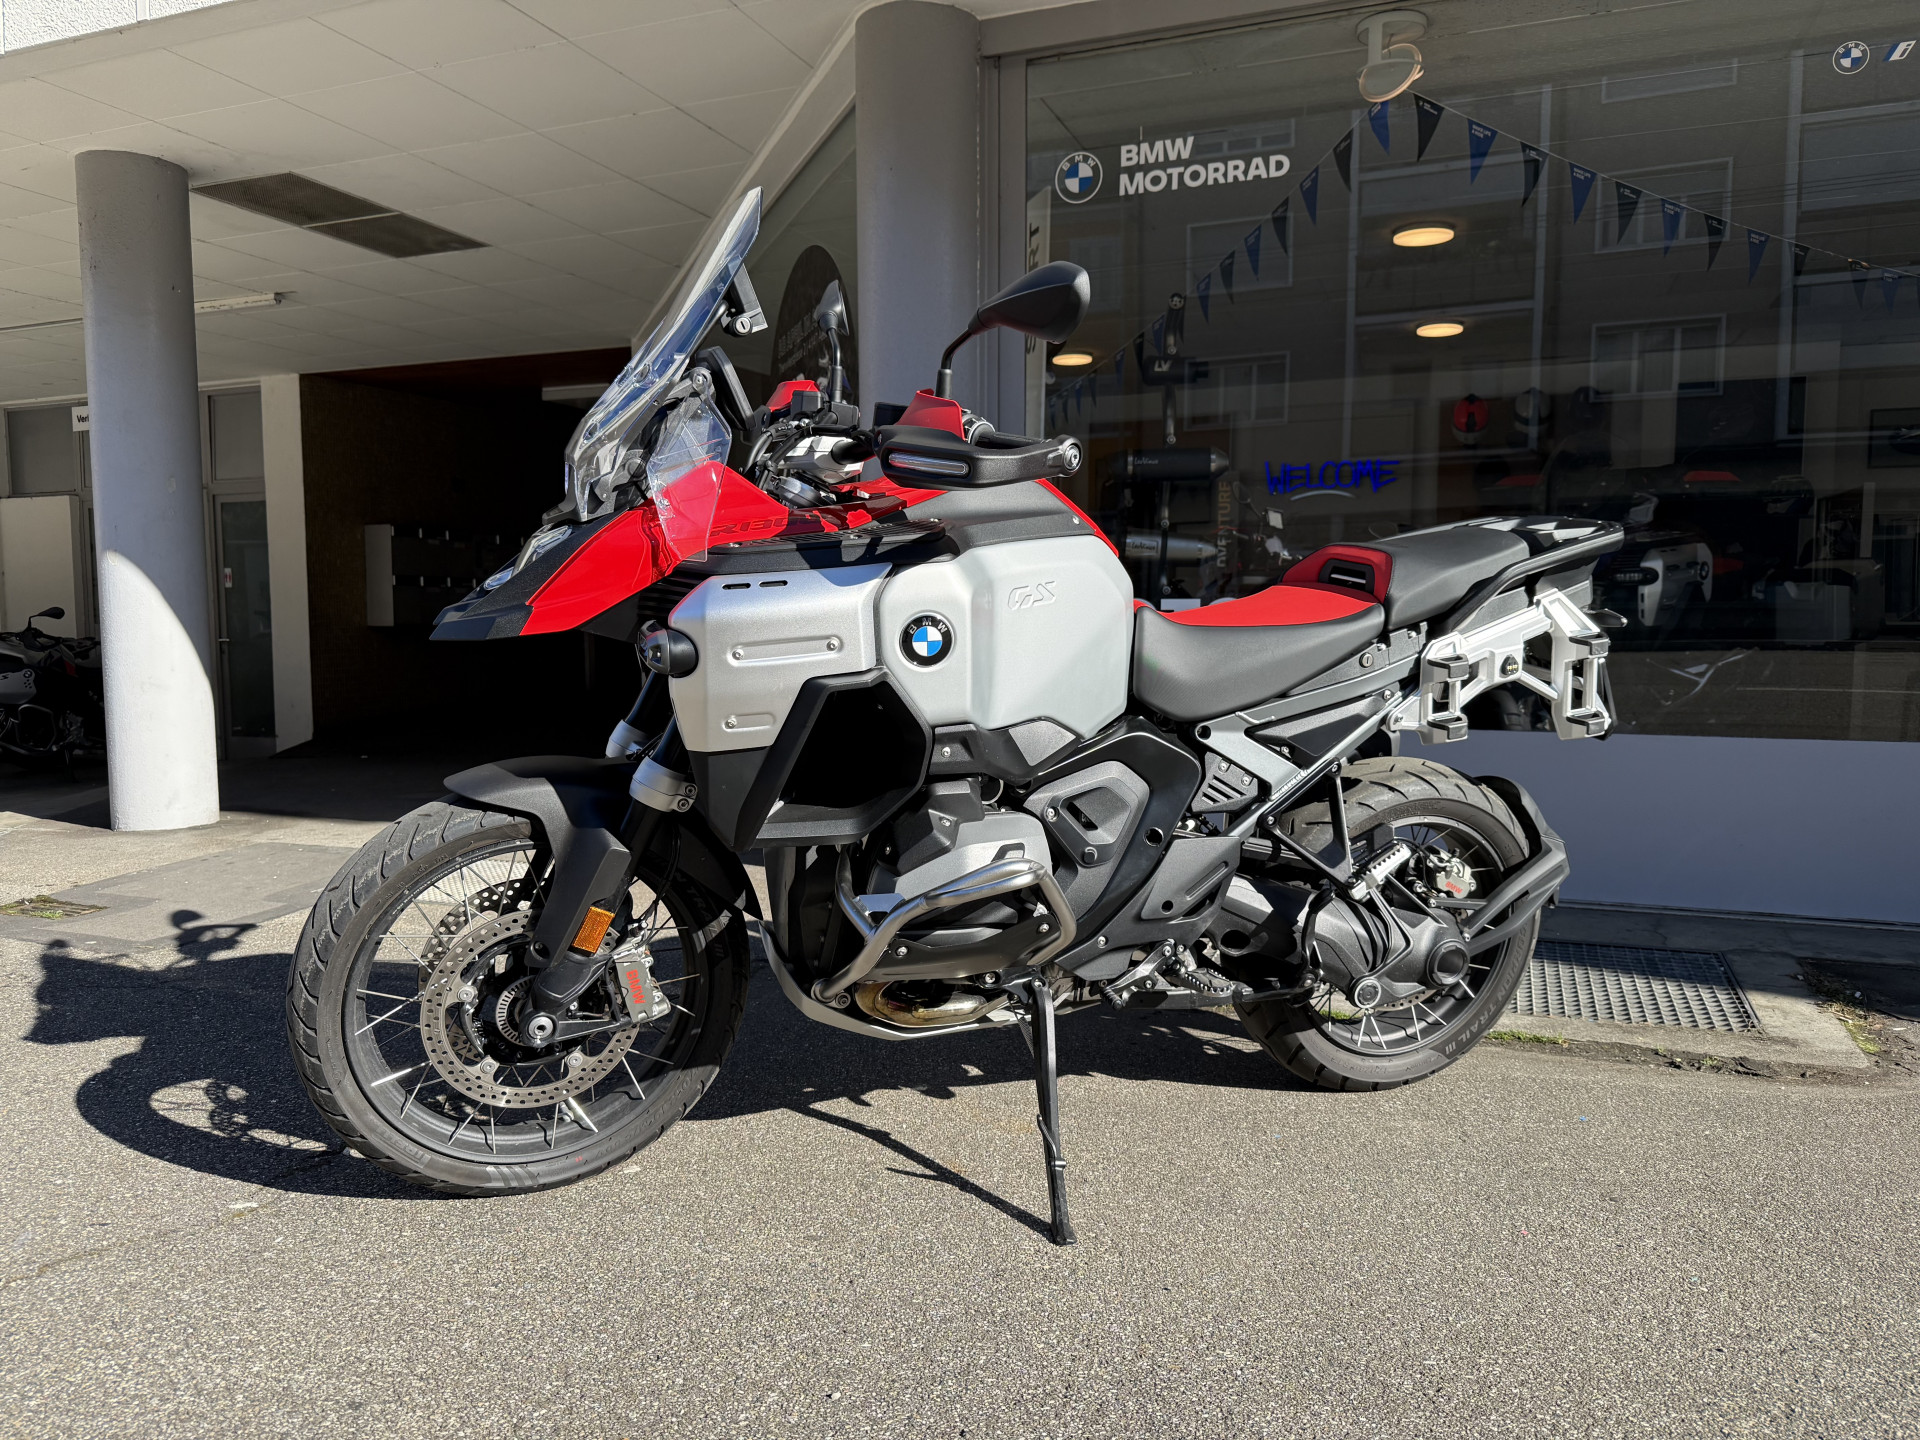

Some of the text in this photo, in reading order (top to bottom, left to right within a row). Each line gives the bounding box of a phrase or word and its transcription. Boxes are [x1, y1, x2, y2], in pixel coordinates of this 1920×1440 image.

[1120, 136, 1194, 168] BMW
[1118, 154, 1291, 197] MOTORRAD
[1154, 359, 1173, 372] LV
[1264, 459, 1401, 495] WELCOME
[1007, 580, 1057, 610] GS
[907, 617, 948, 635] BMW
[1445, 880, 1463, 894] BMW
[626, 969, 646, 1005] BMW
